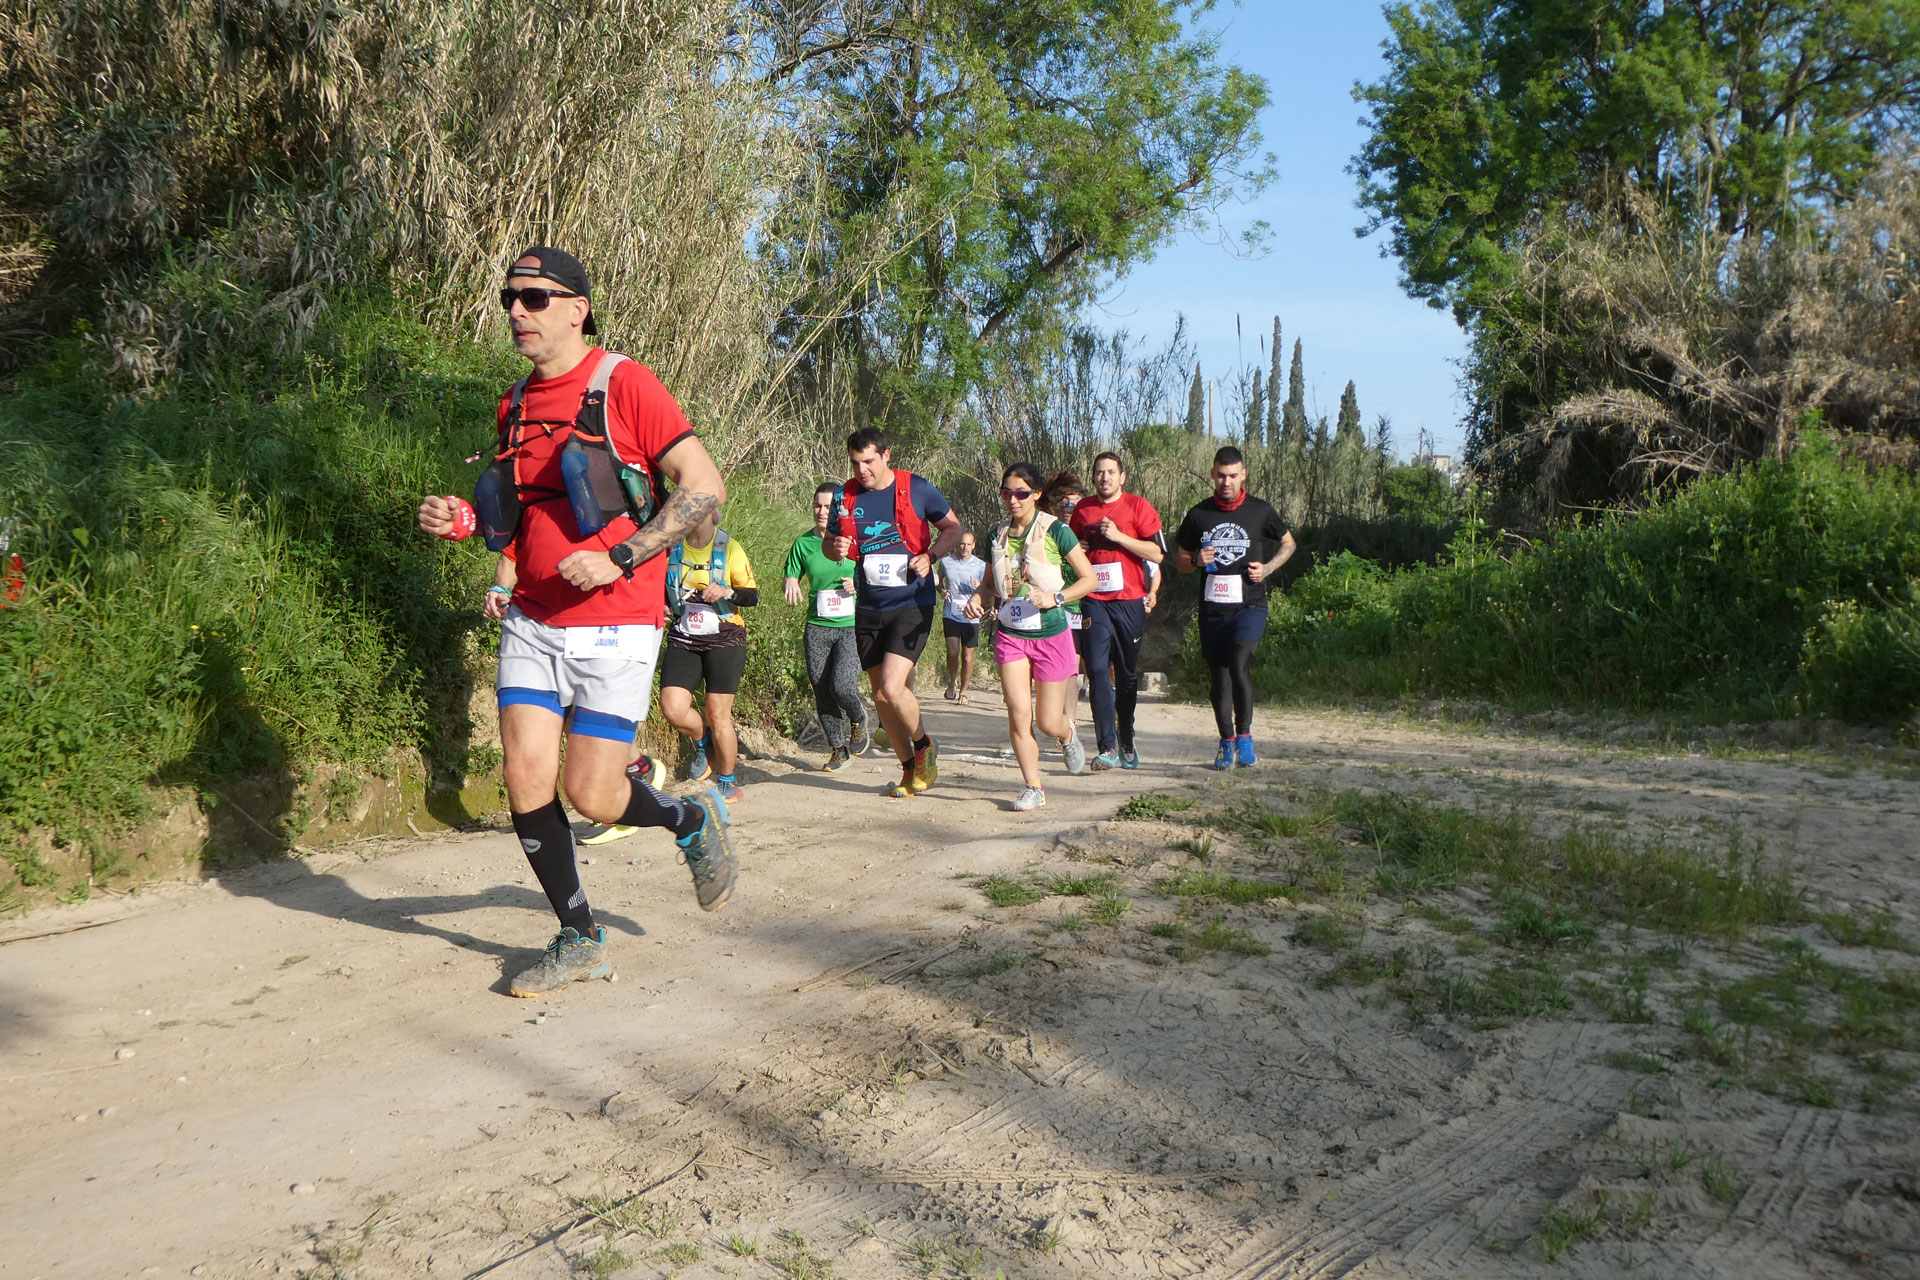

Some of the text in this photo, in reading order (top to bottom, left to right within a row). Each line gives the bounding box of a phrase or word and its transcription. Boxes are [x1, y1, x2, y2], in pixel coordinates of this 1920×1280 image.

[879, 563, 890, 574] 32
[1097, 571, 1110, 581] 289
[1214, 583, 1229, 592] 200
[827, 597, 842, 606] 290
[1010, 605, 1022, 617] 33
[688, 611, 704, 623] 283
[594, 638, 619, 647] JAUME
